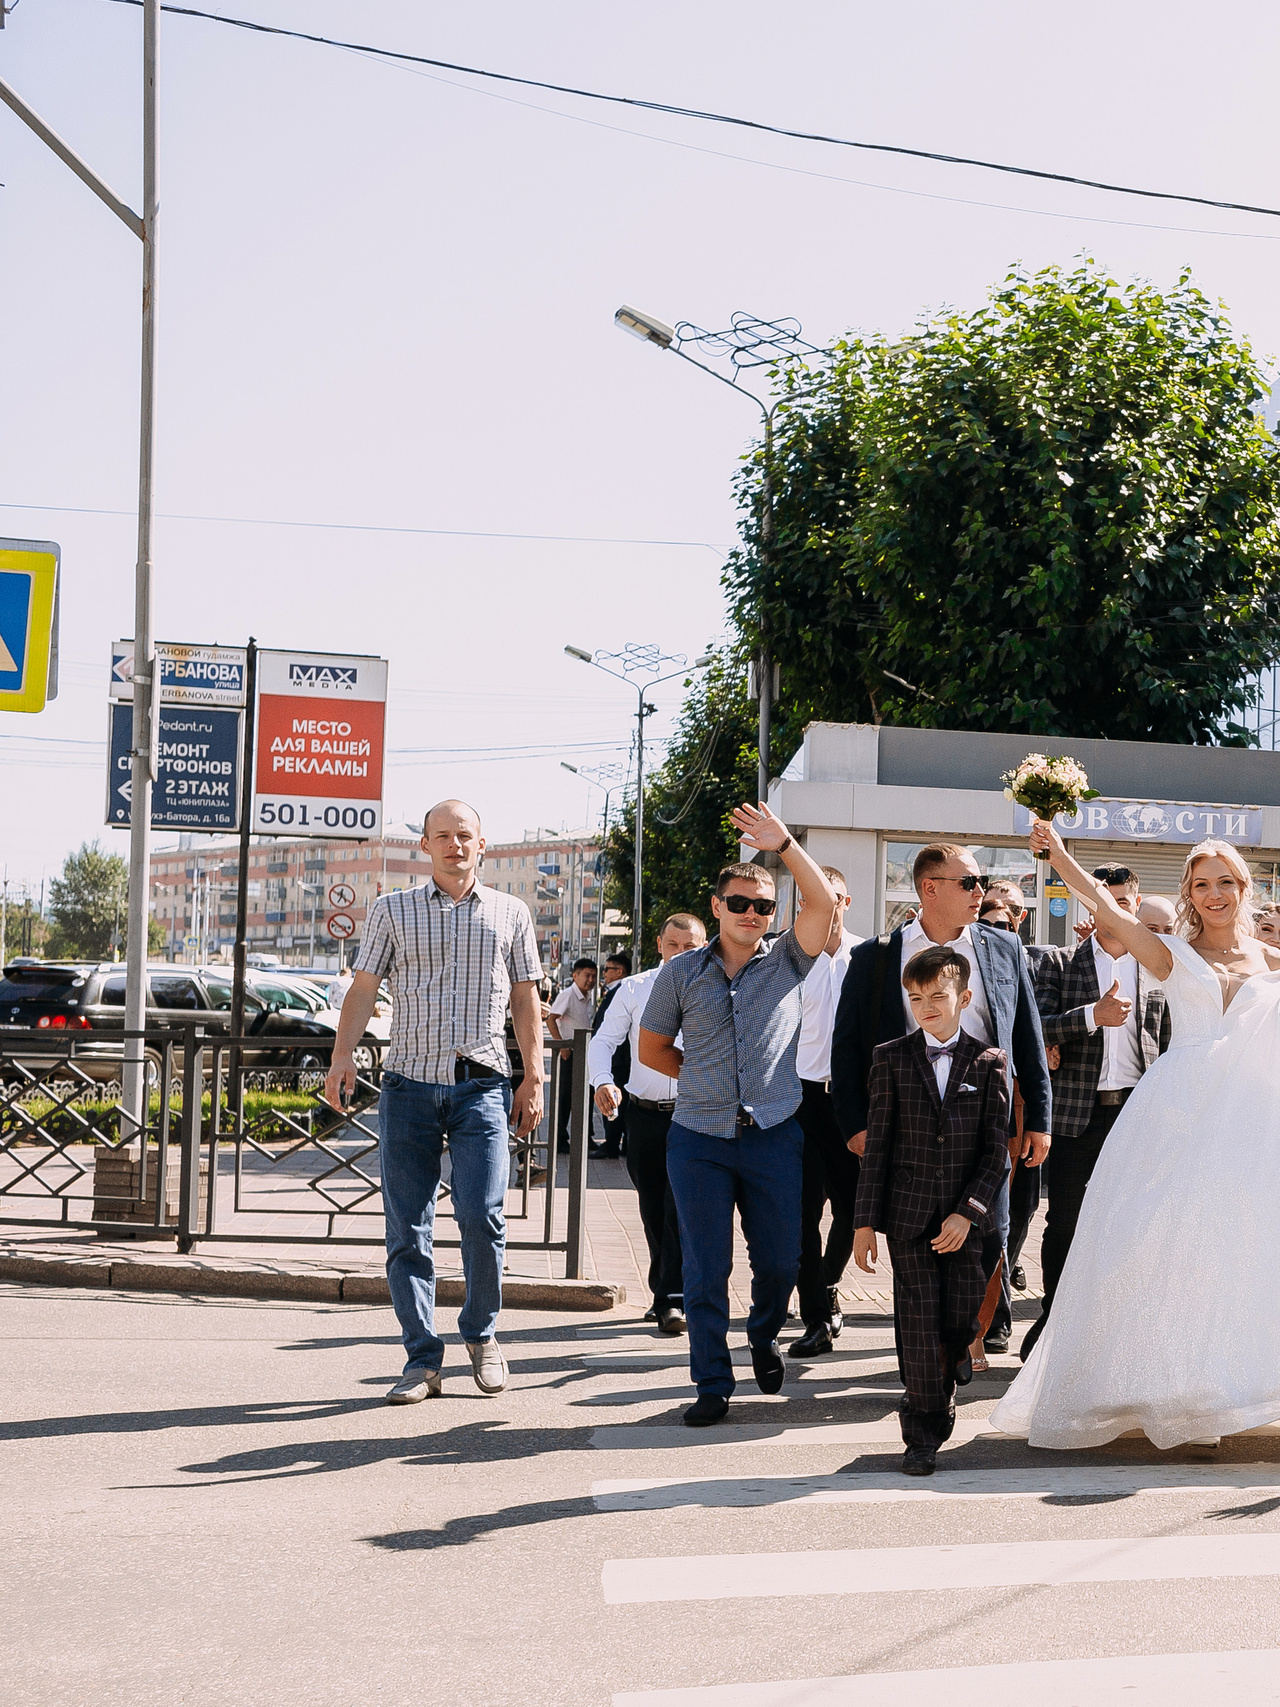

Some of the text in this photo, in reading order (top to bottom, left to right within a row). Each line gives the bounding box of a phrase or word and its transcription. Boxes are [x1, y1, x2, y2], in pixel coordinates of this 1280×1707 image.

[293, 665, 355, 684] MAX
[214, 681, 240, 689] улица
[293, 681, 352, 690] MEDIA
[162, 689, 240, 702] ERBANOVA street
[292, 719, 351, 737] МЕСТО
[158, 742, 210, 758] ЕМОНТ
[270, 737, 371, 757] ДЛЯ ВАШЕЙ
[273, 756, 368, 777] РЕКЛАМЫ
[178, 780, 229, 796] ЭТАЖ
[166, 797, 176, 805] ТЦ
[214, 813, 230, 823] 16а
[260, 803, 376, 830] 501-000
